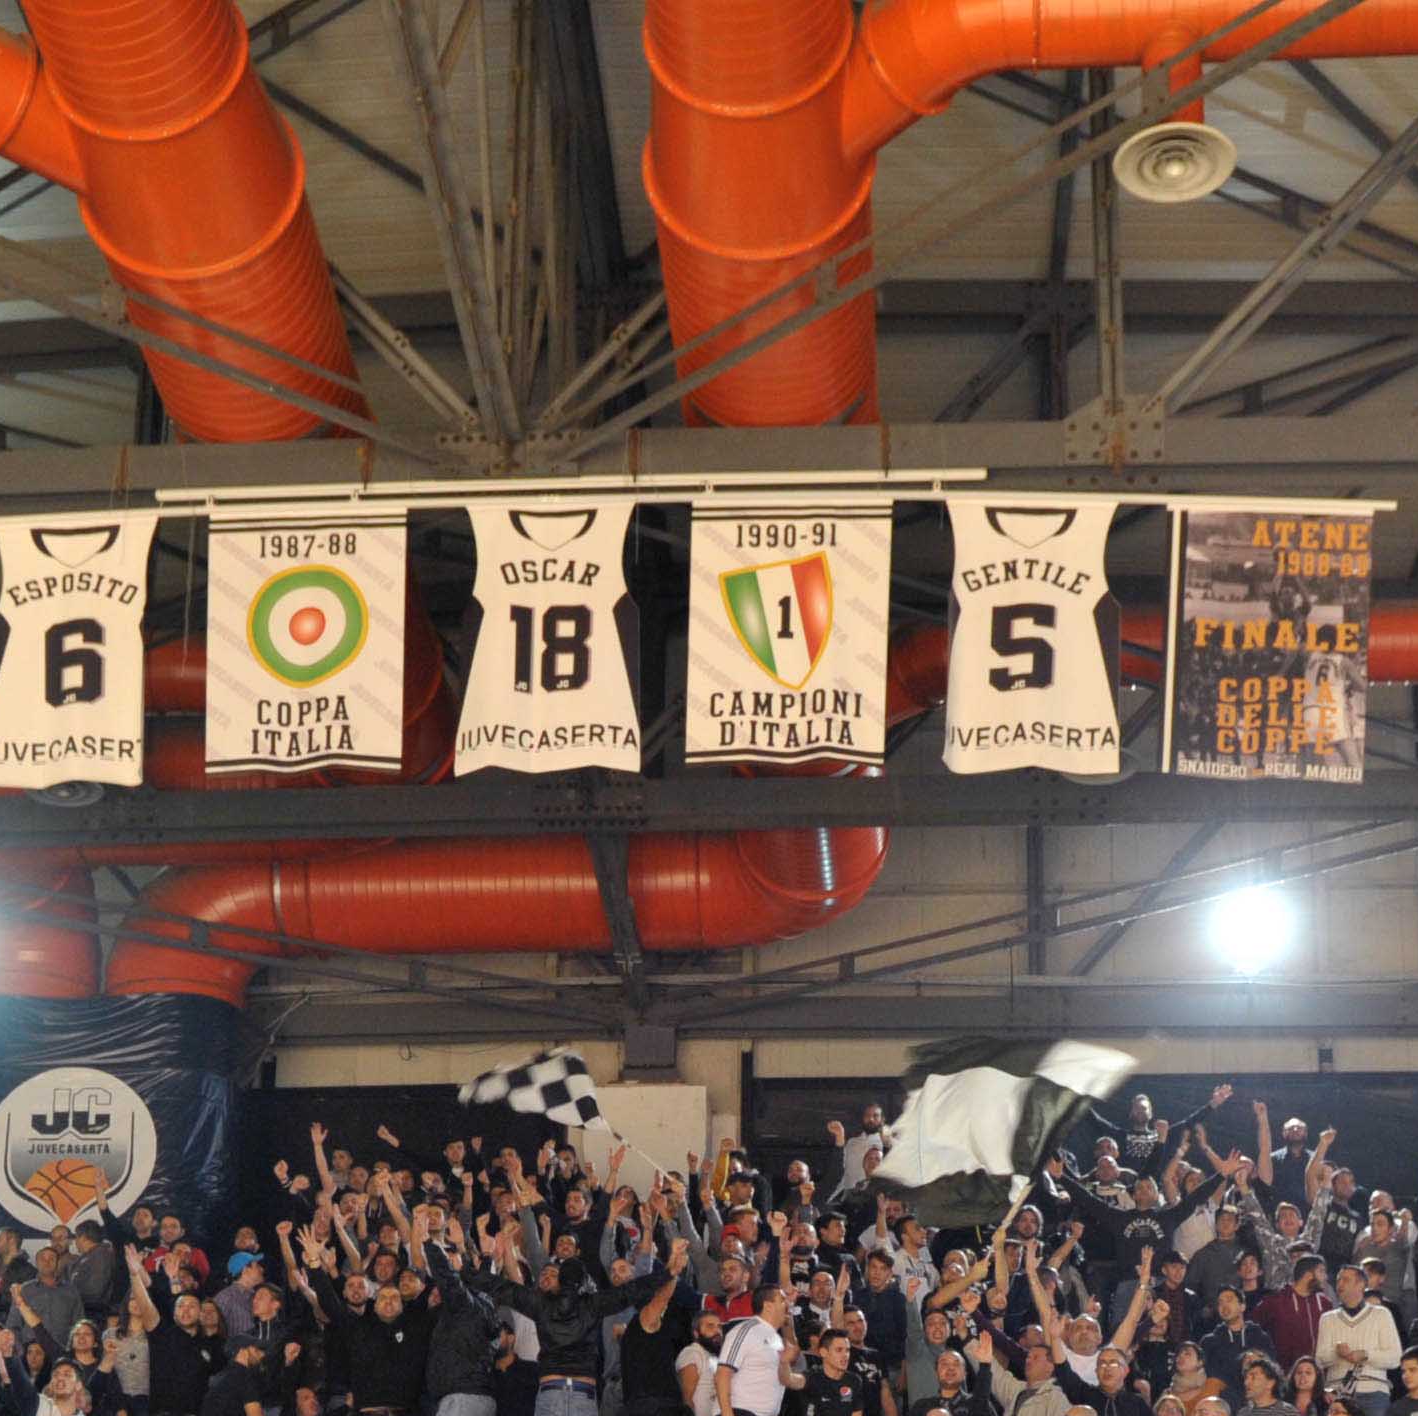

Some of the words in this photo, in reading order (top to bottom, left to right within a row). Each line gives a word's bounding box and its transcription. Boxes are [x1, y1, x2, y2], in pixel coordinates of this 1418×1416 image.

[260, 533, 357, 560] 1987-88
[736, 523, 837, 548] 1990-91
[1252, 520, 1370, 550] ATENE
[500, 558, 601, 587] OSCAR
[961, 558, 1092, 595] GENTILE
[6, 571, 139, 608] ESPOSITO
[777, 596, 794, 639] 1
[510, 604, 592, 694] 18
[989, 603, 1056, 691] 5
[1193, 617, 1361, 653] FINALE
[44, 617, 107, 709] 6
[710, 689, 862, 718] CAMPIONI
[1218, 677, 1335, 703] COPPA
[256, 695, 350, 728] COPPA
[1216, 703, 1337, 729] DELLE
[251, 724, 355, 757] ITALIA
[459, 724, 637, 754] JUVECASERTA
[719, 720, 854, 748] D'ITALIA
[1216, 728, 1335, 756] COPPE
[1265, 763, 1303, 780] REAL
[1306, 764, 1363, 783] MADRID
[31, 1087, 112, 1135] JC
[28, 1143, 110, 1155] JUVECASERTA
